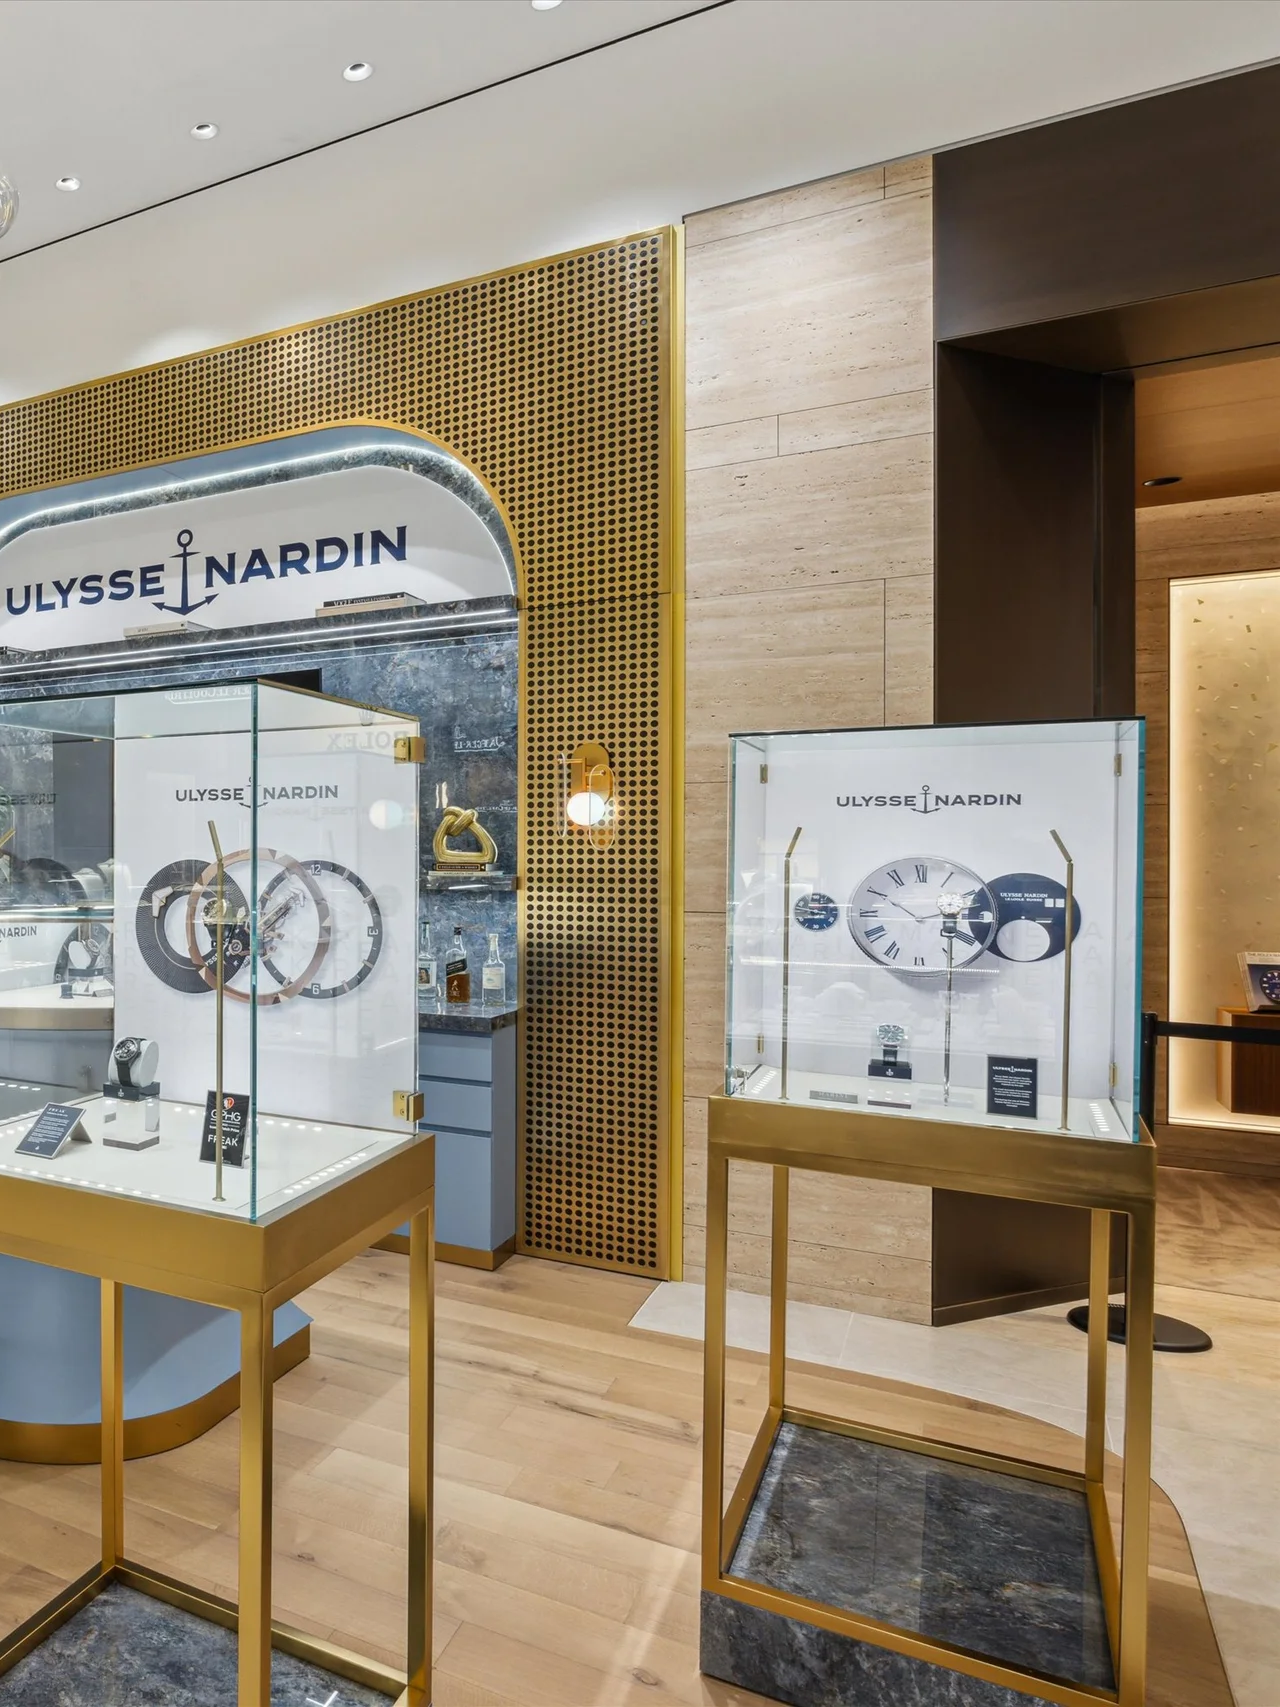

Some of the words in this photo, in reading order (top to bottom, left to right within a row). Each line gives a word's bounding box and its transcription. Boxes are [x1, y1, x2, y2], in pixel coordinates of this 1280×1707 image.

[6, 563, 166, 616] ULYSSE
[205, 525, 408, 588] NARDIN
[175, 787, 244, 802] ULYSSE
[263, 784, 339, 800] NARDIN
[836, 795, 917, 807] ULYSSE
[935, 793, 1022, 806] NARDIN
[311, 864, 321, 874] 12
[312, 984, 320, 995] 6
